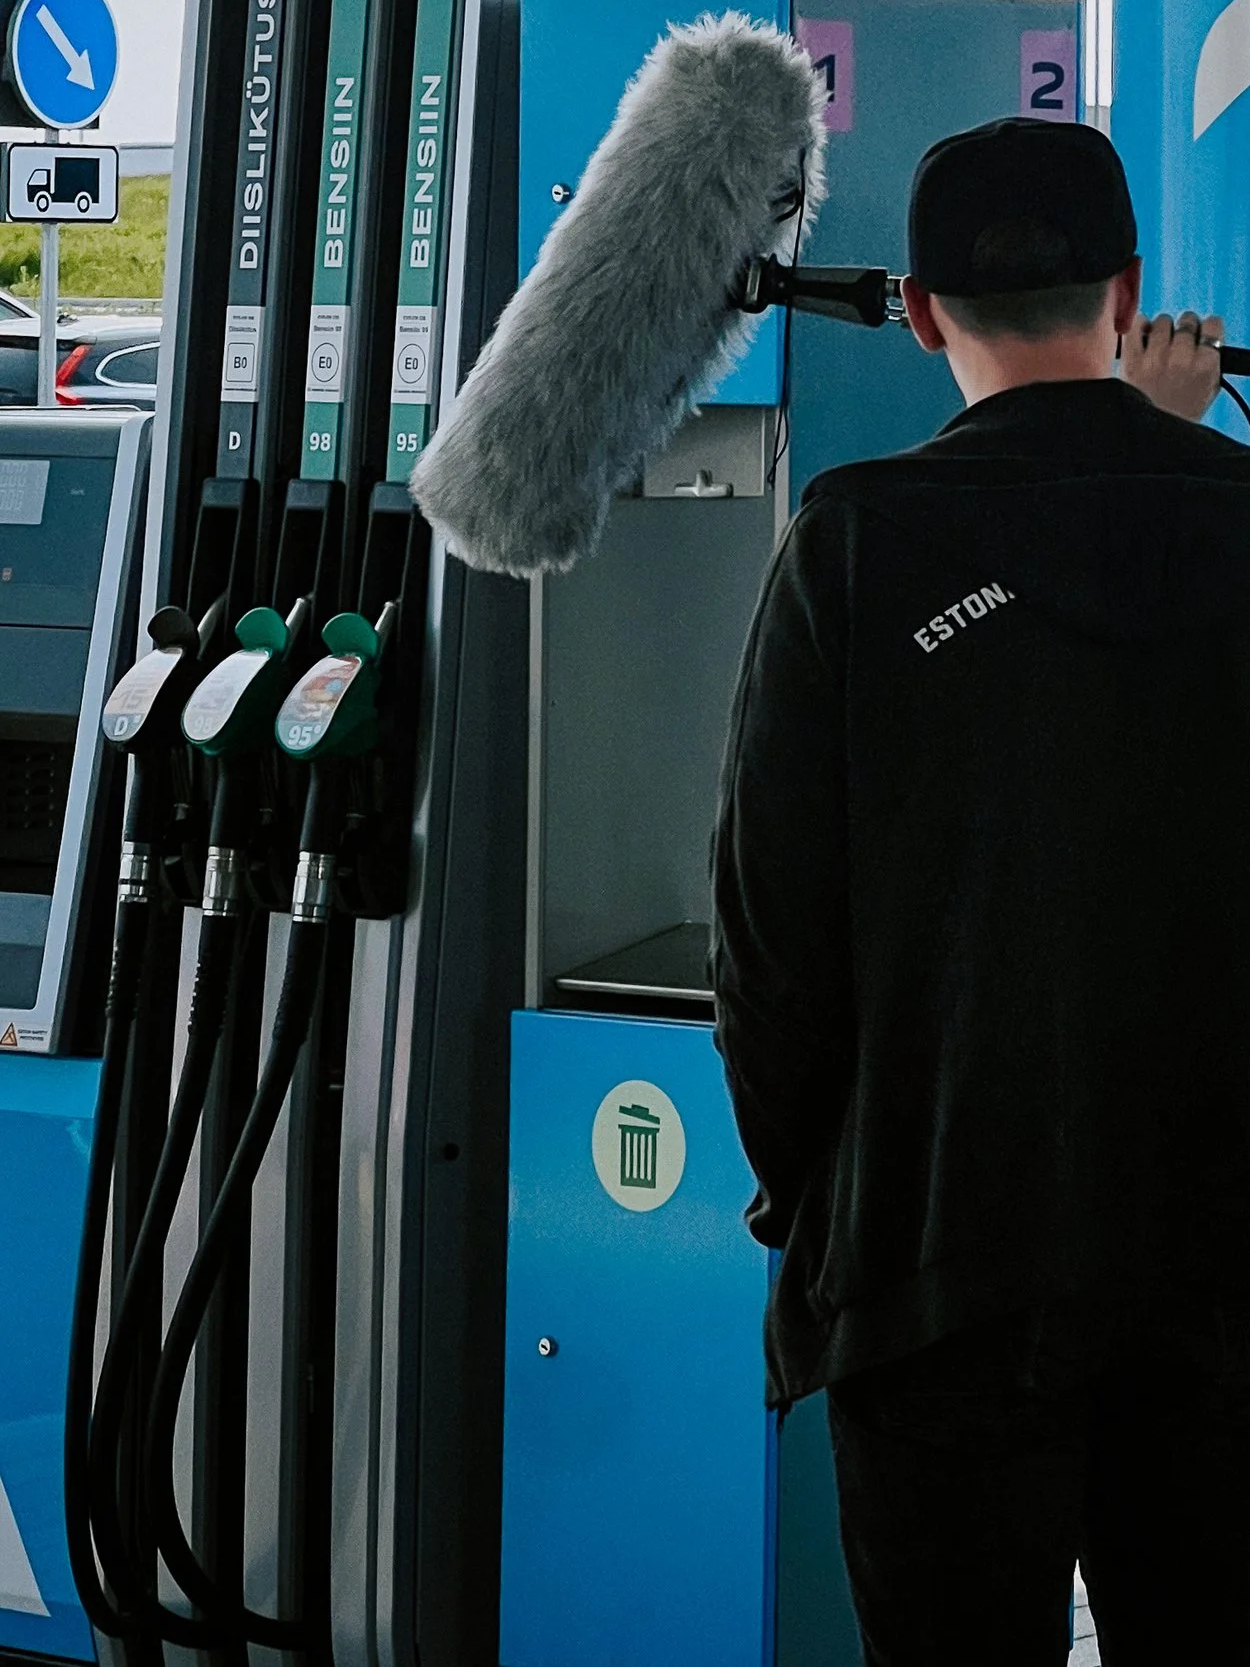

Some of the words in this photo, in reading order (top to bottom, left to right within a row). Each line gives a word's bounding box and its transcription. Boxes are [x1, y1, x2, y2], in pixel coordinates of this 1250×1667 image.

[813, 53, 836, 103] 1
[1030, 61, 1066, 110] 2
[323, 76, 356, 269] BENSIIN
[410, 74, 442, 269] BENSIIN
[233, 356, 248, 369] B0
[318, 356, 333, 369] E0
[404, 357, 419, 370] E0
[228, 431, 241, 450] D
[309, 432, 331, 452] 98
[396, 432, 418, 452] 95
[913, 582, 1016, 653] ESTON
